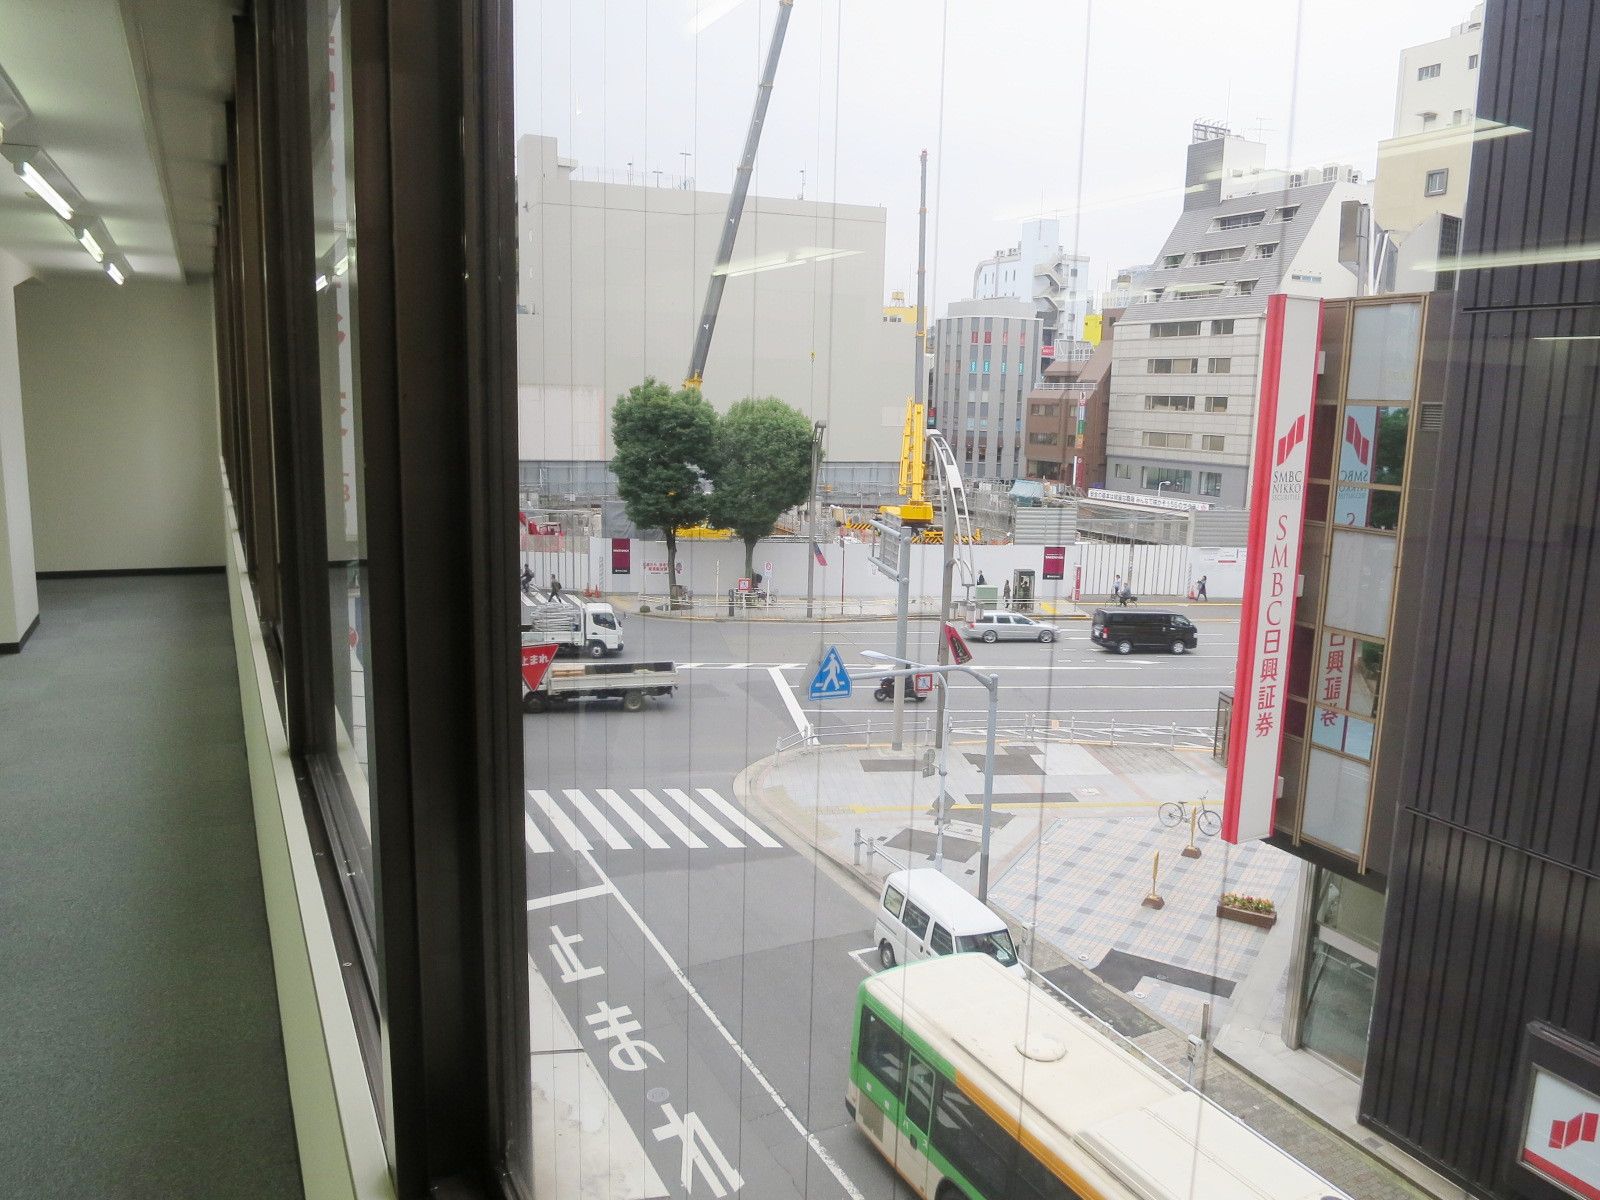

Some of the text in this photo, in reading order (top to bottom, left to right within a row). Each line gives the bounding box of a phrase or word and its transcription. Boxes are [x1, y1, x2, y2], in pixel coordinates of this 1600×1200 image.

[1272, 483, 1301, 494] NIKKO
[1273, 470, 1302, 482] SMBC
[1255, 514, 1288, 738] SMBC日興証券
[548, 924, 745, 1198] 止まれ
